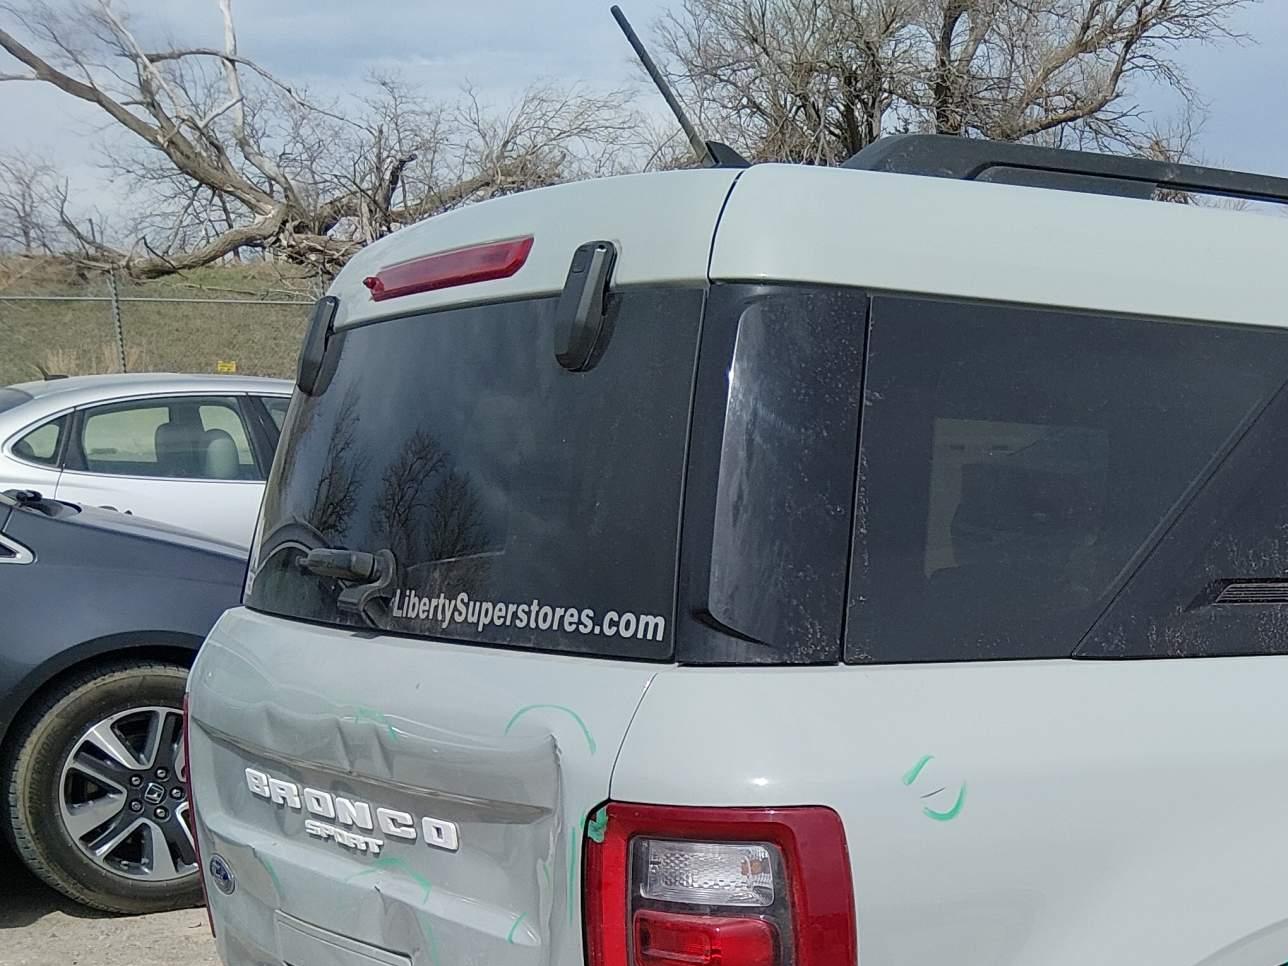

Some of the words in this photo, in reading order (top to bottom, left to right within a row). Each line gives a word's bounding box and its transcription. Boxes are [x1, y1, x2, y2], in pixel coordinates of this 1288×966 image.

[393, 590, 665, 641] LibertySuperstores.com
[245, 768, 460, 850] BRONCO
[304, 821, 384, 854] SPORT
